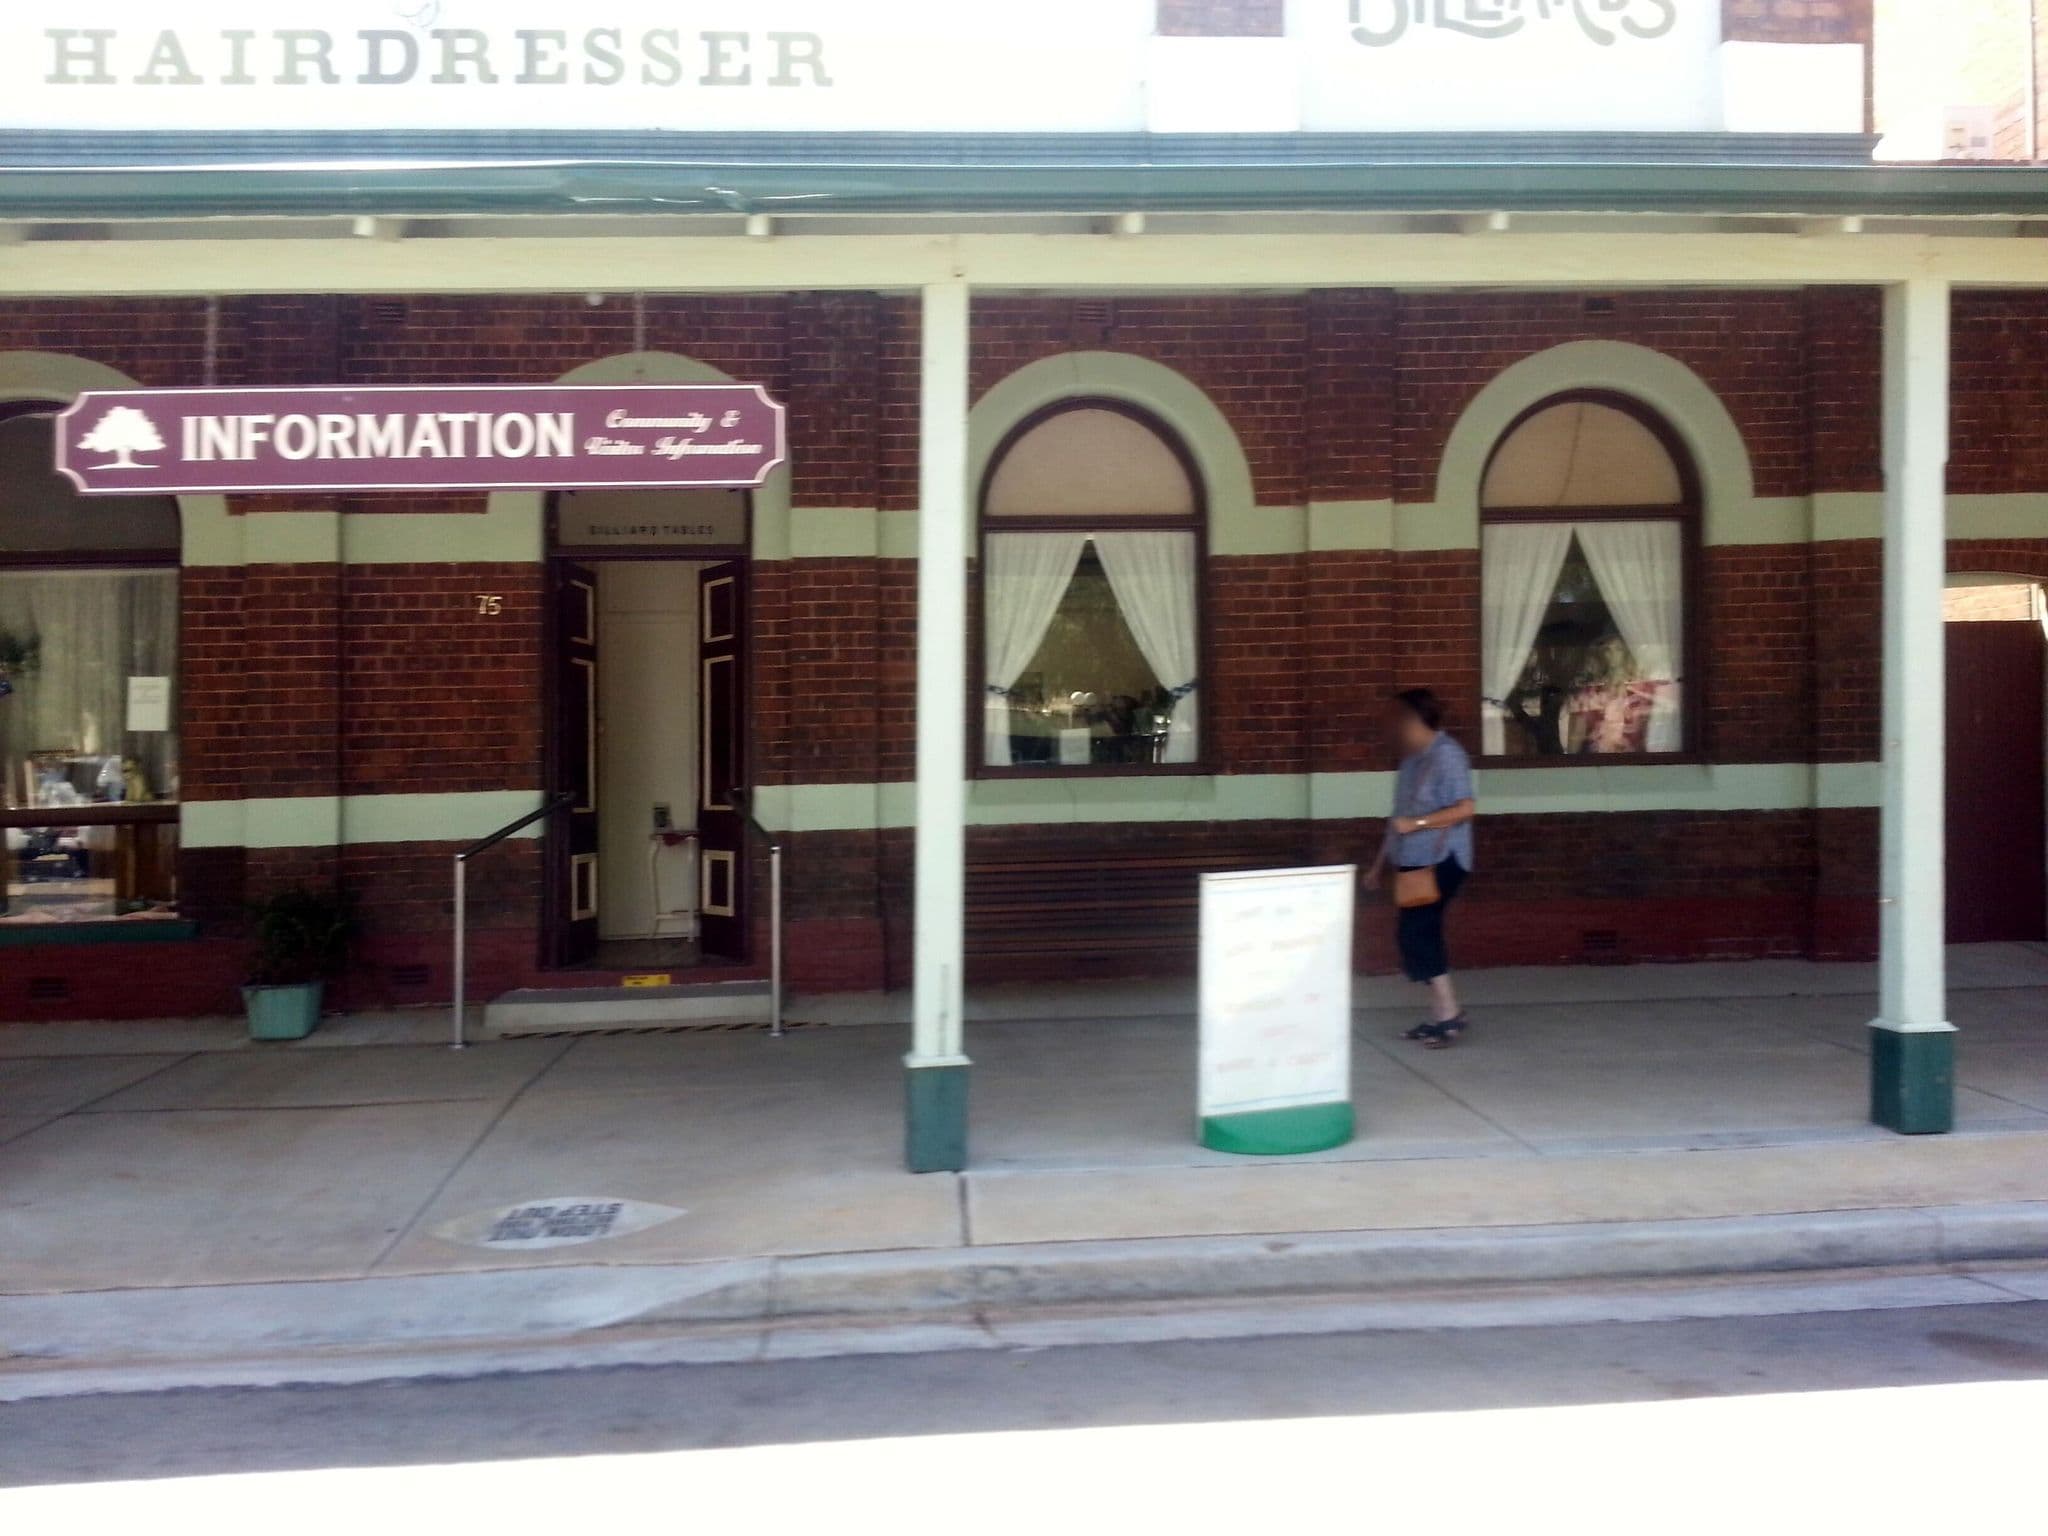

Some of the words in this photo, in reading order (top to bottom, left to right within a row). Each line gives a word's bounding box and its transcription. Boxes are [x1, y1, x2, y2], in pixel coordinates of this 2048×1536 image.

[44, 28, 834, 87] HAIRDRESSER
[181, 412, 575, 461] INFORMATION
[475, 594, 503, 616] 75
